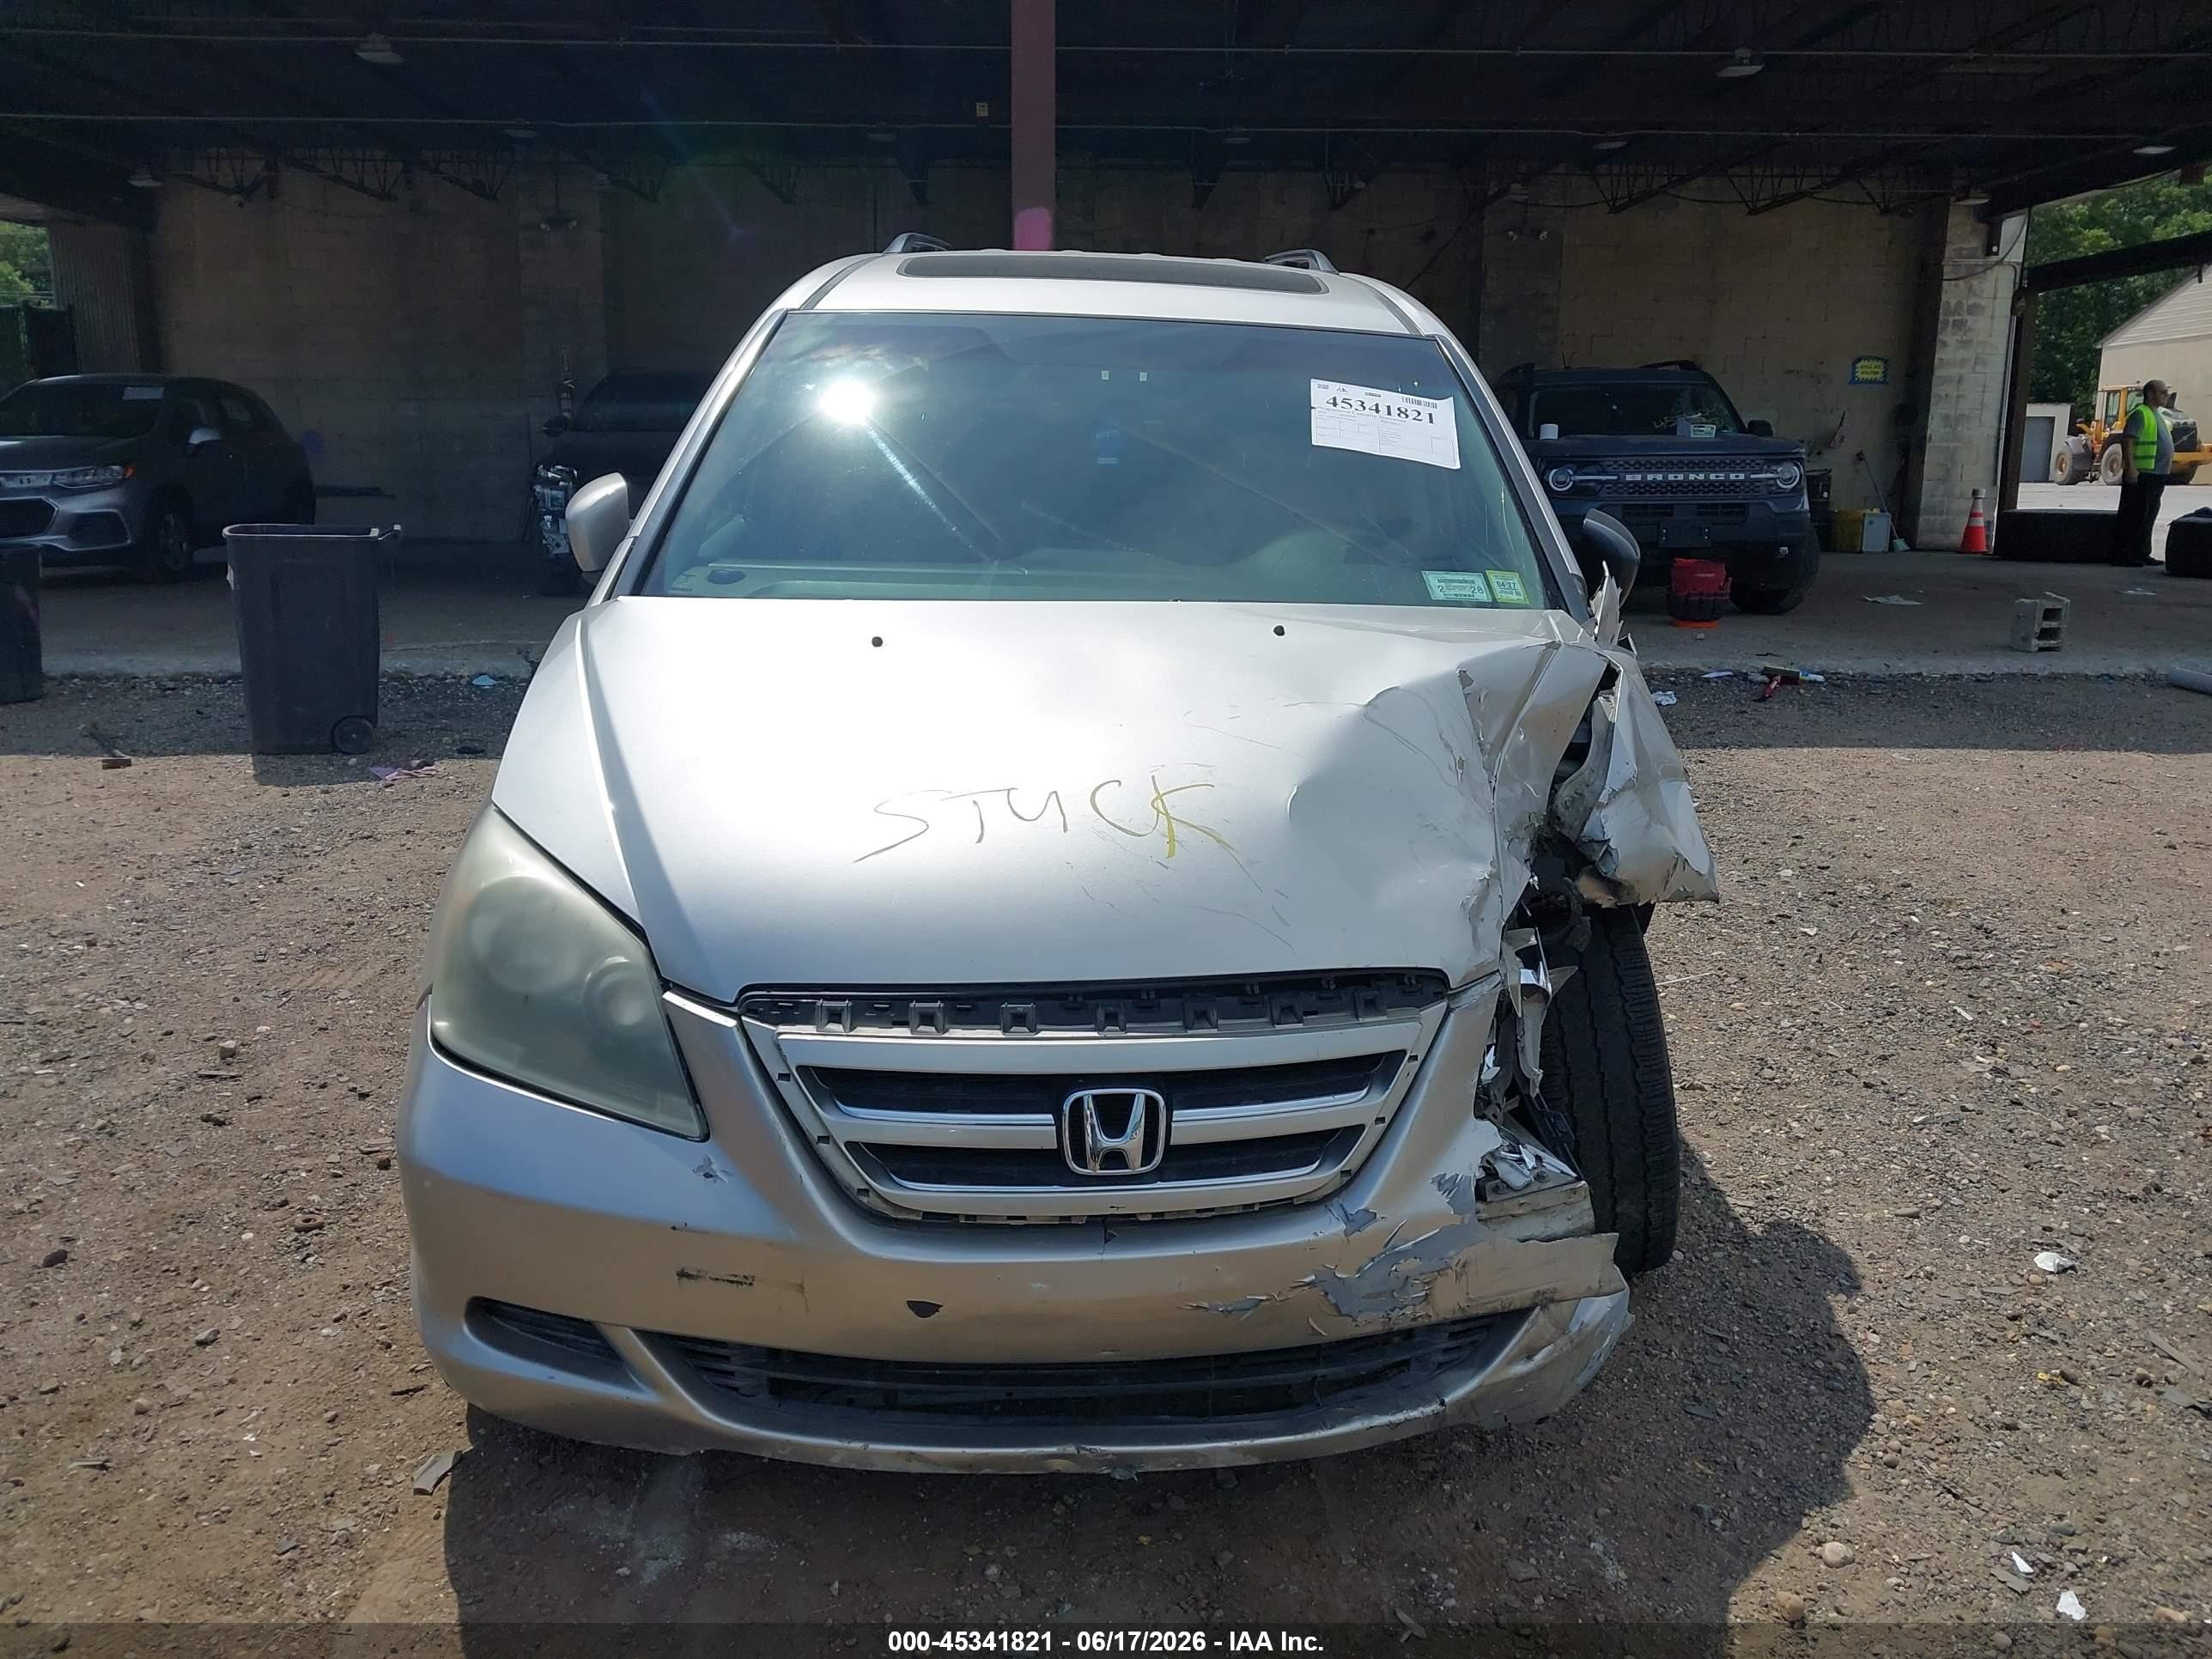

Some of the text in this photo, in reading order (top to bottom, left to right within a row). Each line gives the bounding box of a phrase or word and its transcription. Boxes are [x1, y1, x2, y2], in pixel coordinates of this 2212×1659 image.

[1325, 396, 1437, 425] 45341821
[1626, 472, 1746, 481] BRONCO
[854, 775, 1240, 863] STUCK
